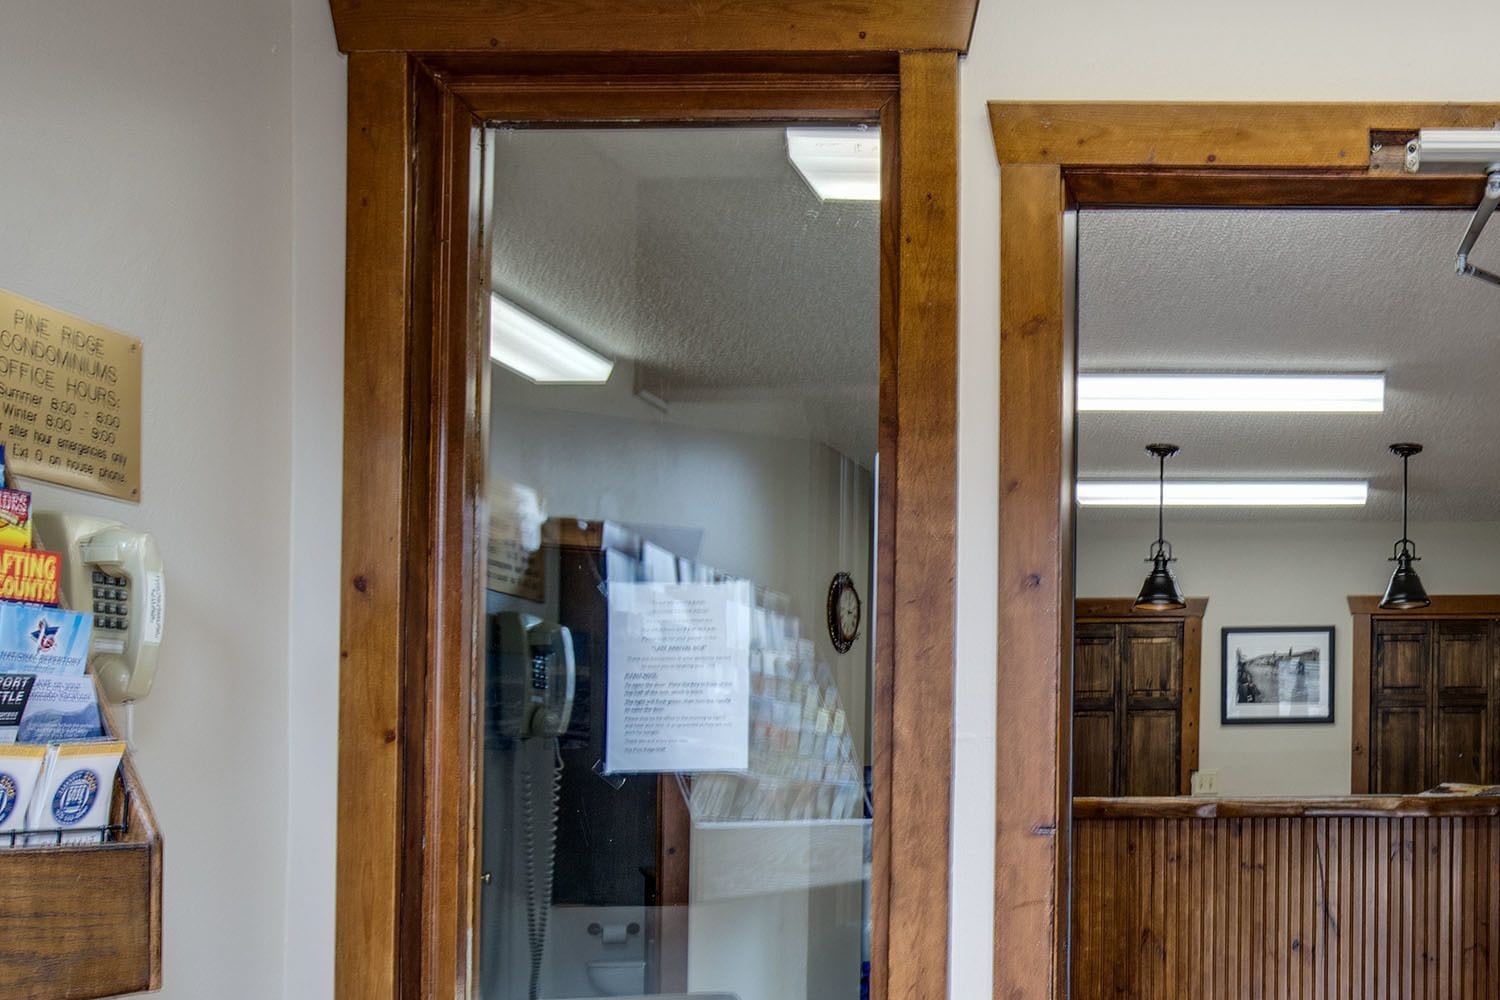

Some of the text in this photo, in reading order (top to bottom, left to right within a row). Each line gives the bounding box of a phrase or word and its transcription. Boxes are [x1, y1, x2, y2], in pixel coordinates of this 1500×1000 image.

[14, 309, 104, 359] PINE RIDGE
[0, 330, 118, 386] CONDOMINIUMS
[0, 355, 120, 409] OFFICE HOURS:
[3, 402, 38, 422] Winter
[45, 414, 72, 434] 8:00
[51, 398, 76, 416] 8:00
[0, 691, 24, 703] TLE
